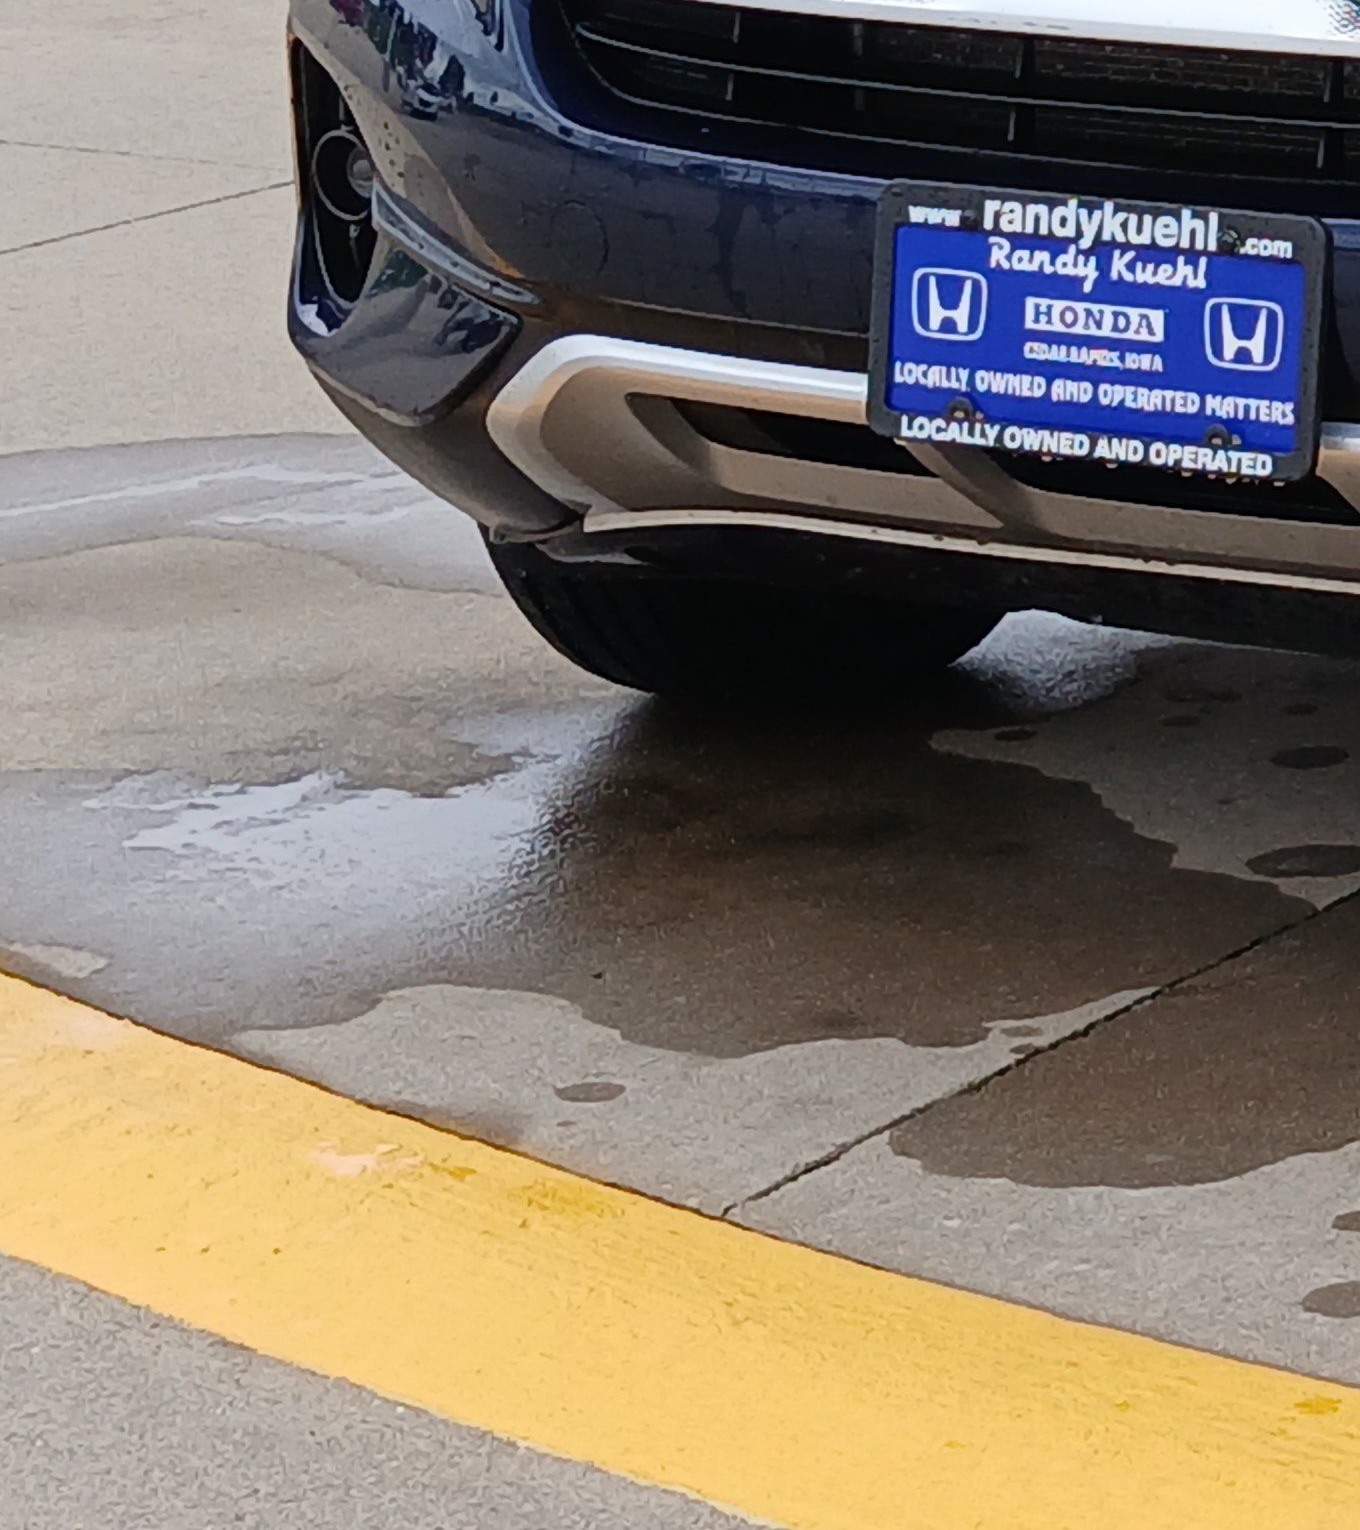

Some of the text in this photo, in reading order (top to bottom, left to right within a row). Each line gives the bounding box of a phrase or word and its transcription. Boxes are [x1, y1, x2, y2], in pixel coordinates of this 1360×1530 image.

[988, 236, 1208, 294] Randy Kuehl
[1032, 302, 1157, 337] HONDA
[894, 360, 1296, 425] LOCALLY OWNED AND OPERATED MATTERS
[901, 414, 1273, 477] LOCALLY OWNED AND OPERATED
